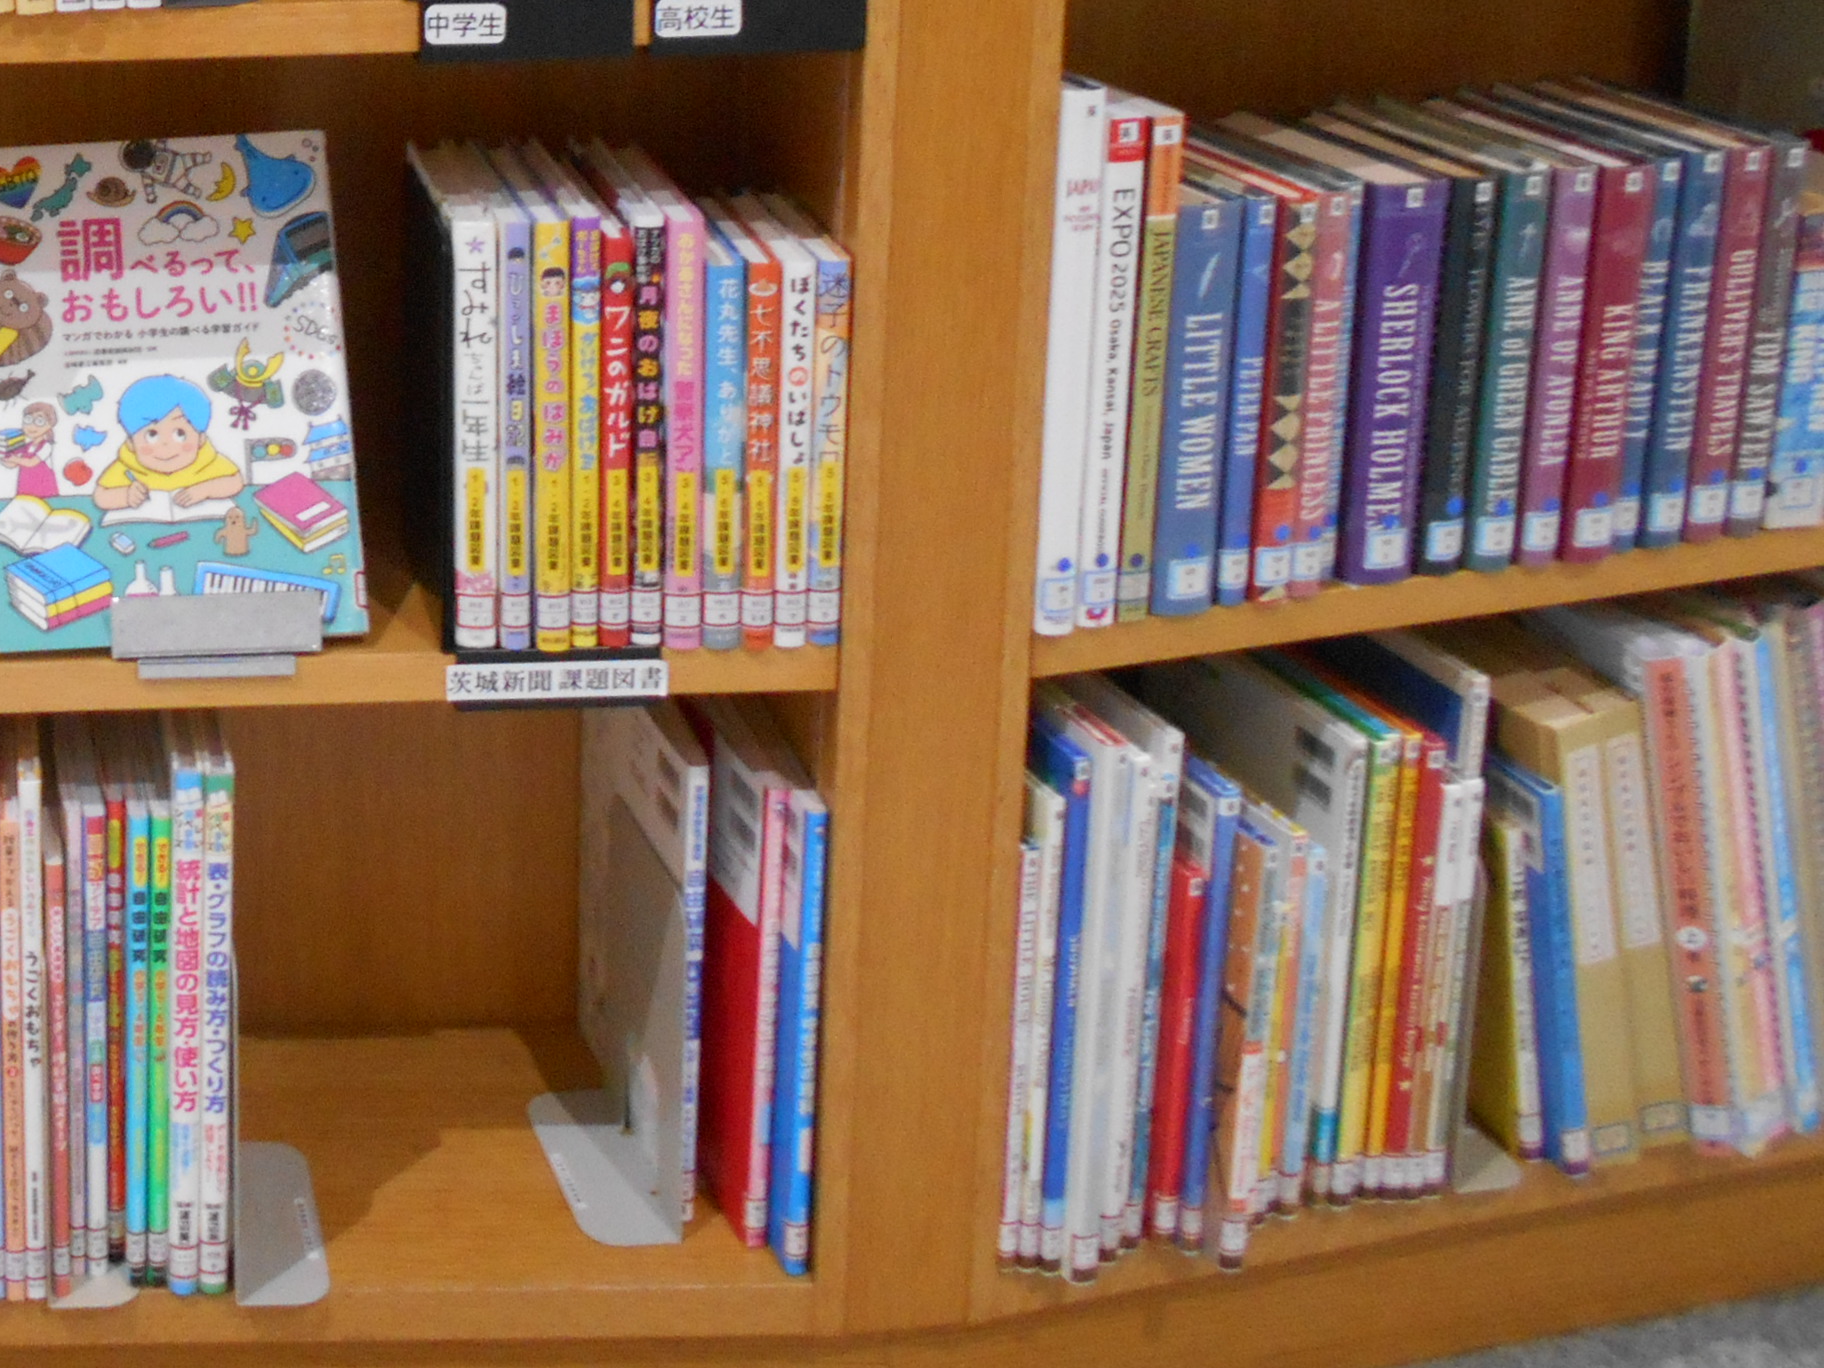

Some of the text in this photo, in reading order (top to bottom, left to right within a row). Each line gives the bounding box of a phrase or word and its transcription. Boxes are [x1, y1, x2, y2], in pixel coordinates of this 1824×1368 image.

[426, 11, 505, 39] 中学生
[657, 5, 737, 32] 高校生
[56, 217, 256, 283] 調べるって、
[1109, 187, 1137, 258] EXPO
[1108, 261, 1129, 314] 2025
[1502, 276, 1539, 332] ANNE
[1553, 276, 1586, 332] ANNE
[1372, 282, 1420, 420] SHERLOCK
[1600, 302, 1635, 361] KING
[604, 305, 632, 459] ワニのガルド
[748, 303, 773, 464] 七不思議神社
[1174, 312, 1224, 510] LITTLE WOMEN
[448, 665, 663, 694] 茨城新聞 課題図書
[174, 858, 203, 1114] 統計と地図の見方・使い方
